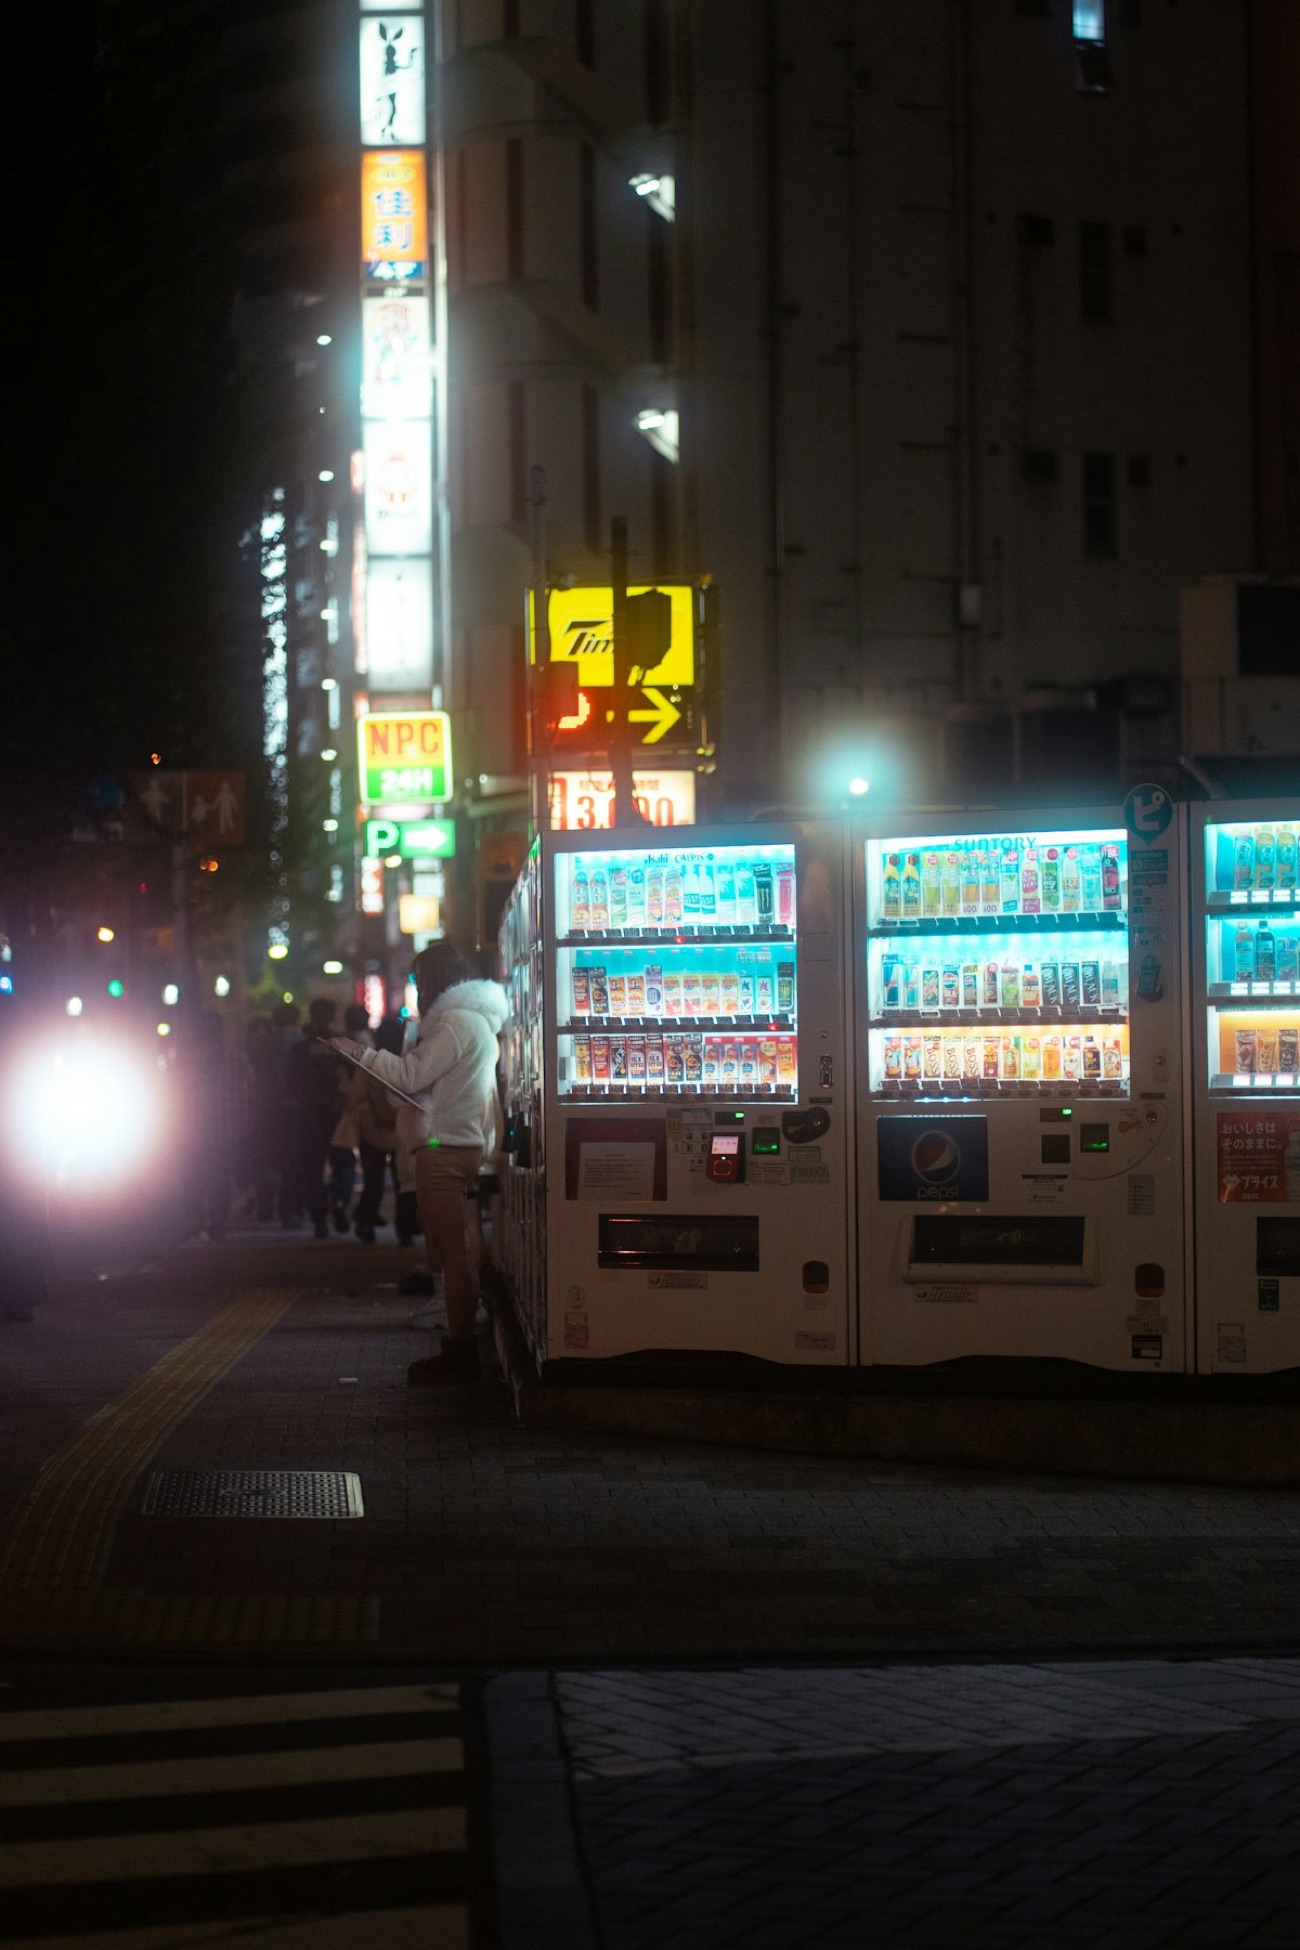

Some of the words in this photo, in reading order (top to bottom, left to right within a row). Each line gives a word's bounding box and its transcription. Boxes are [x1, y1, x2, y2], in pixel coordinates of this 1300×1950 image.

[368, 721, 440, 757] NPC
[380, 767, 434, 794] 24H
[1132, 790, 1166, 832] ピ
[366, 821, 400, 859] P
[953, 836, 1037, 852] SUNTORY
[1221, 1121, 1277, 1135] おいしさは
[916, 1183, 960, 1201] pepsi
